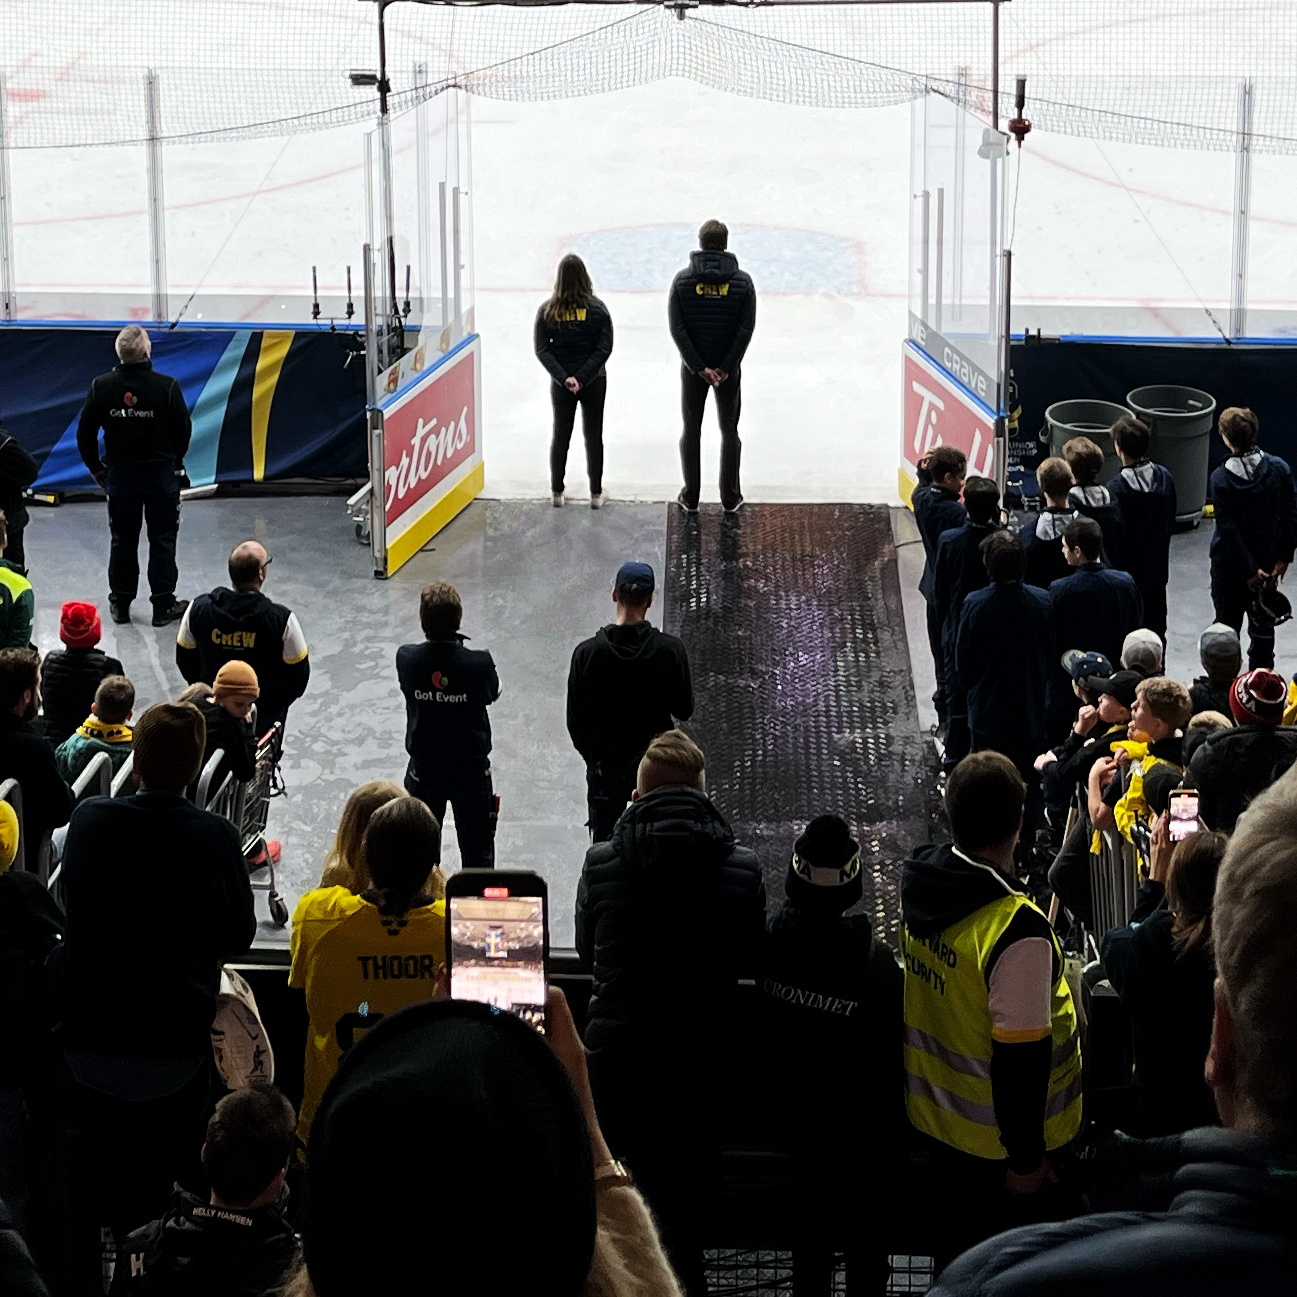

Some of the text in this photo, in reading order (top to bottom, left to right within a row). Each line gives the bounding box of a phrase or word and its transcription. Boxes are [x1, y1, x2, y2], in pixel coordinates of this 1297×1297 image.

[695, 283, 730, 297] CREW
[127, 408, 155, 418] Event
[211, 628, 256, 648] CREW
[414, 689, 468, 704] Got Event
[763, 978, 859, 1017] CRONIMET
[192, 1207, 254, 1227] HELLY HANSEN
